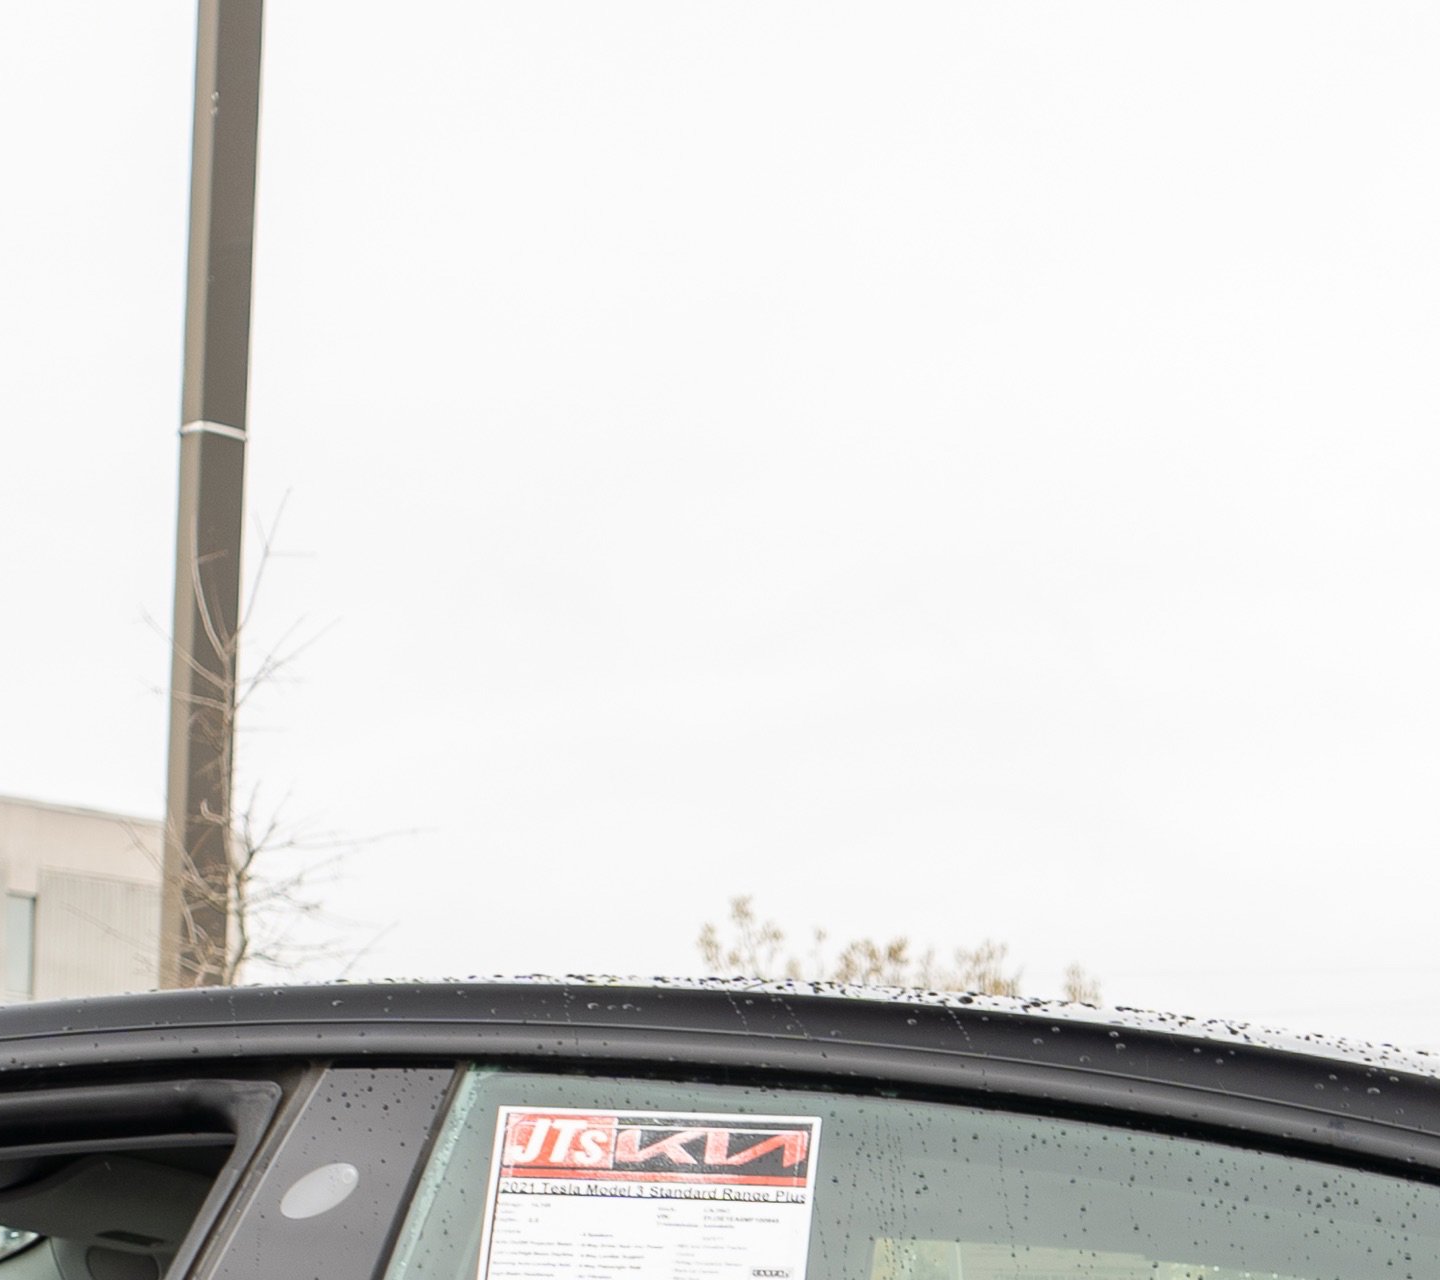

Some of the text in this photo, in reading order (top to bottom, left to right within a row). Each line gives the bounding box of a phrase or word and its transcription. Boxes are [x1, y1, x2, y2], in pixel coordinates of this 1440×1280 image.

[501, 1180, 807, 1204] 2021 Tesla Model 3 Standard Range Plus
